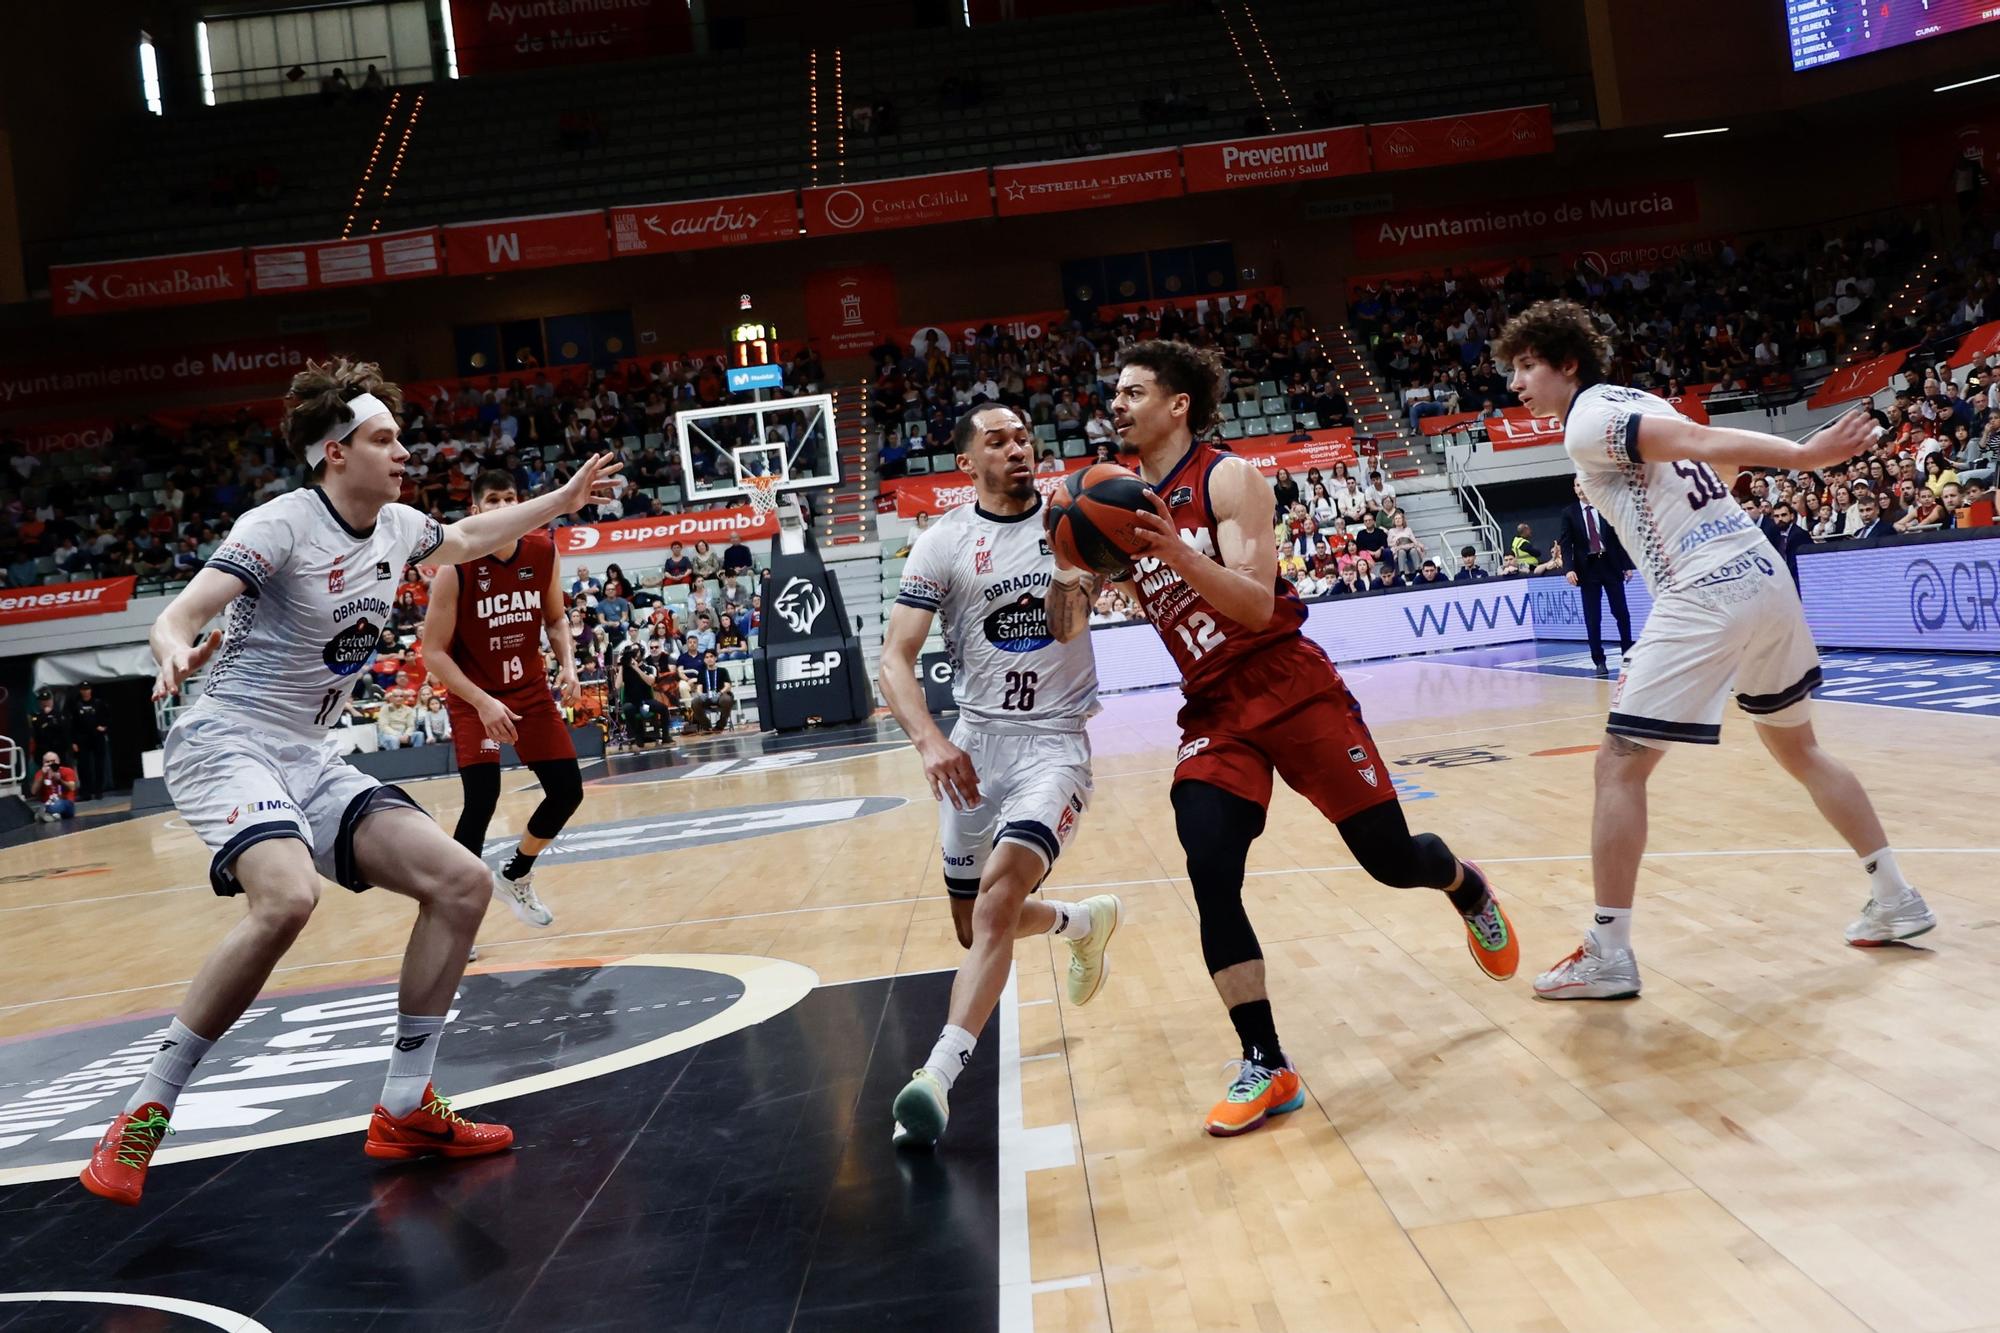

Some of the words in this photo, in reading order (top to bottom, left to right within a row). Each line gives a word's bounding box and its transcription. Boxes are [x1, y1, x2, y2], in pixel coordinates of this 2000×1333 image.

[514, 34, 545, 54] de
[1222, 141, 1328, 169] Prevemur
[1029, 178, 1099, 194] ESTRELLA
[1111, 168, 1173, 186] LEVANTE
[1226, 167, 1287, 183] Prevención
[1289, 167, 1296, 178] y
[1299, 162, 1328, 174] Salud
[872, 199, 915, 213] Costa
[919, 190, 969, 208] Cálida
[1378, 205, 1547, 247] Ayuntamiento
[1553, 198, 1583, 224] de
[1590, 191, 1674, 218] Murcia
[102, 265, 233, 300] CaixaBank
[171, 354, 205, 378] de
[211, 346, 302, 373] Murcia
[740, 341, 769, 366] 17
[610, 513, 766, 542] superDumbo
[333, 598, 390, 624] OBRADOIRO
[477, 590, 541, 619] UCAM
[1173, 591, 1200, 616] JUBILA
[488, 611, 533, 629] MURCIA
[998, 622, 1047, 639] Galicia
[1174, 611, 1227, 661] 12
[503, 656, 523, 684] 19
[776, 678, 831, 690] SOLUTIONS
[1002, 671, 1037, 711] 26
